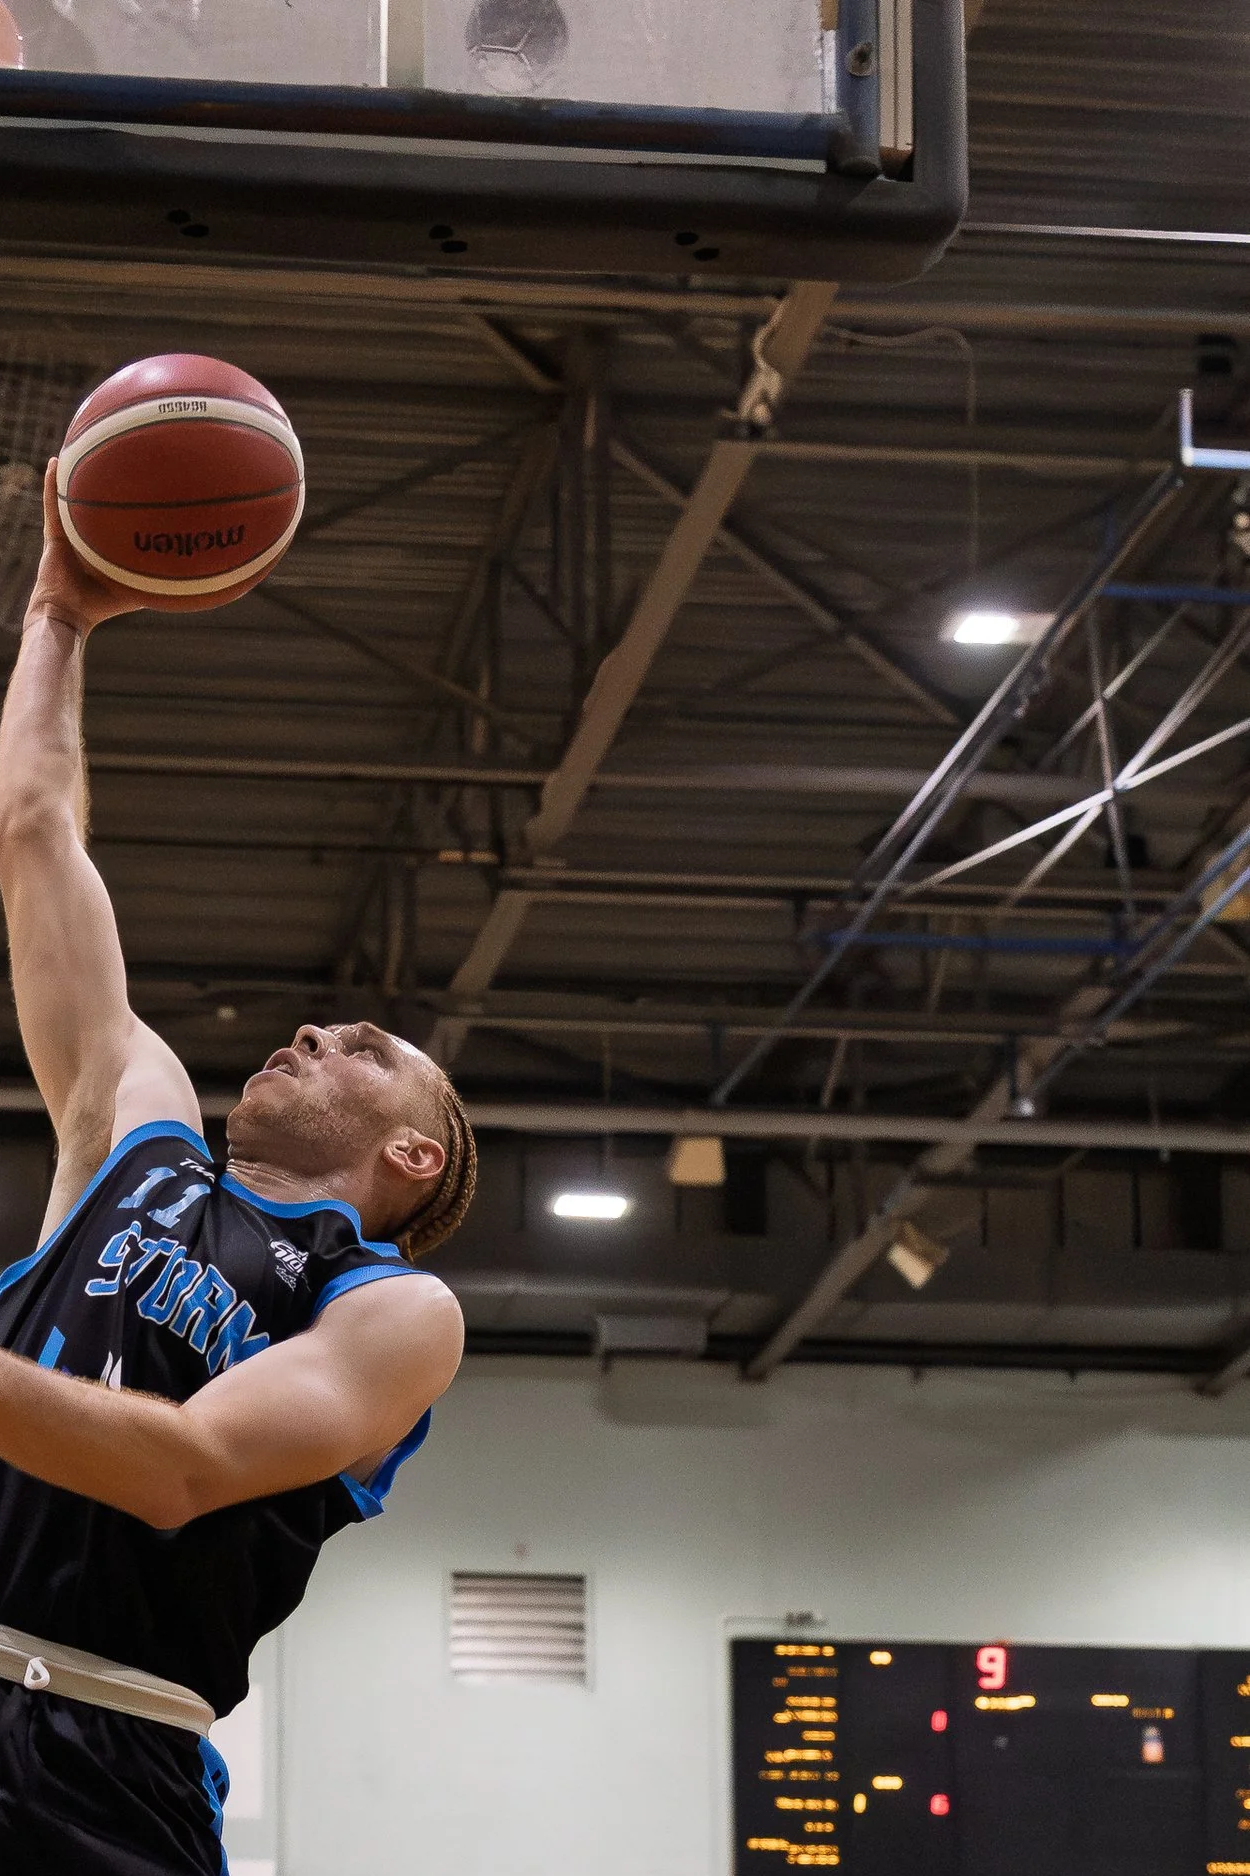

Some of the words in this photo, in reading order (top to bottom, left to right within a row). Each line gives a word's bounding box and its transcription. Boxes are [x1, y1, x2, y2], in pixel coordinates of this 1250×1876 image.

[133, 524, 245, 558] molten
[117, 1166, 211, 1228] 11
[976, 1646, 1007, 1689] 9
